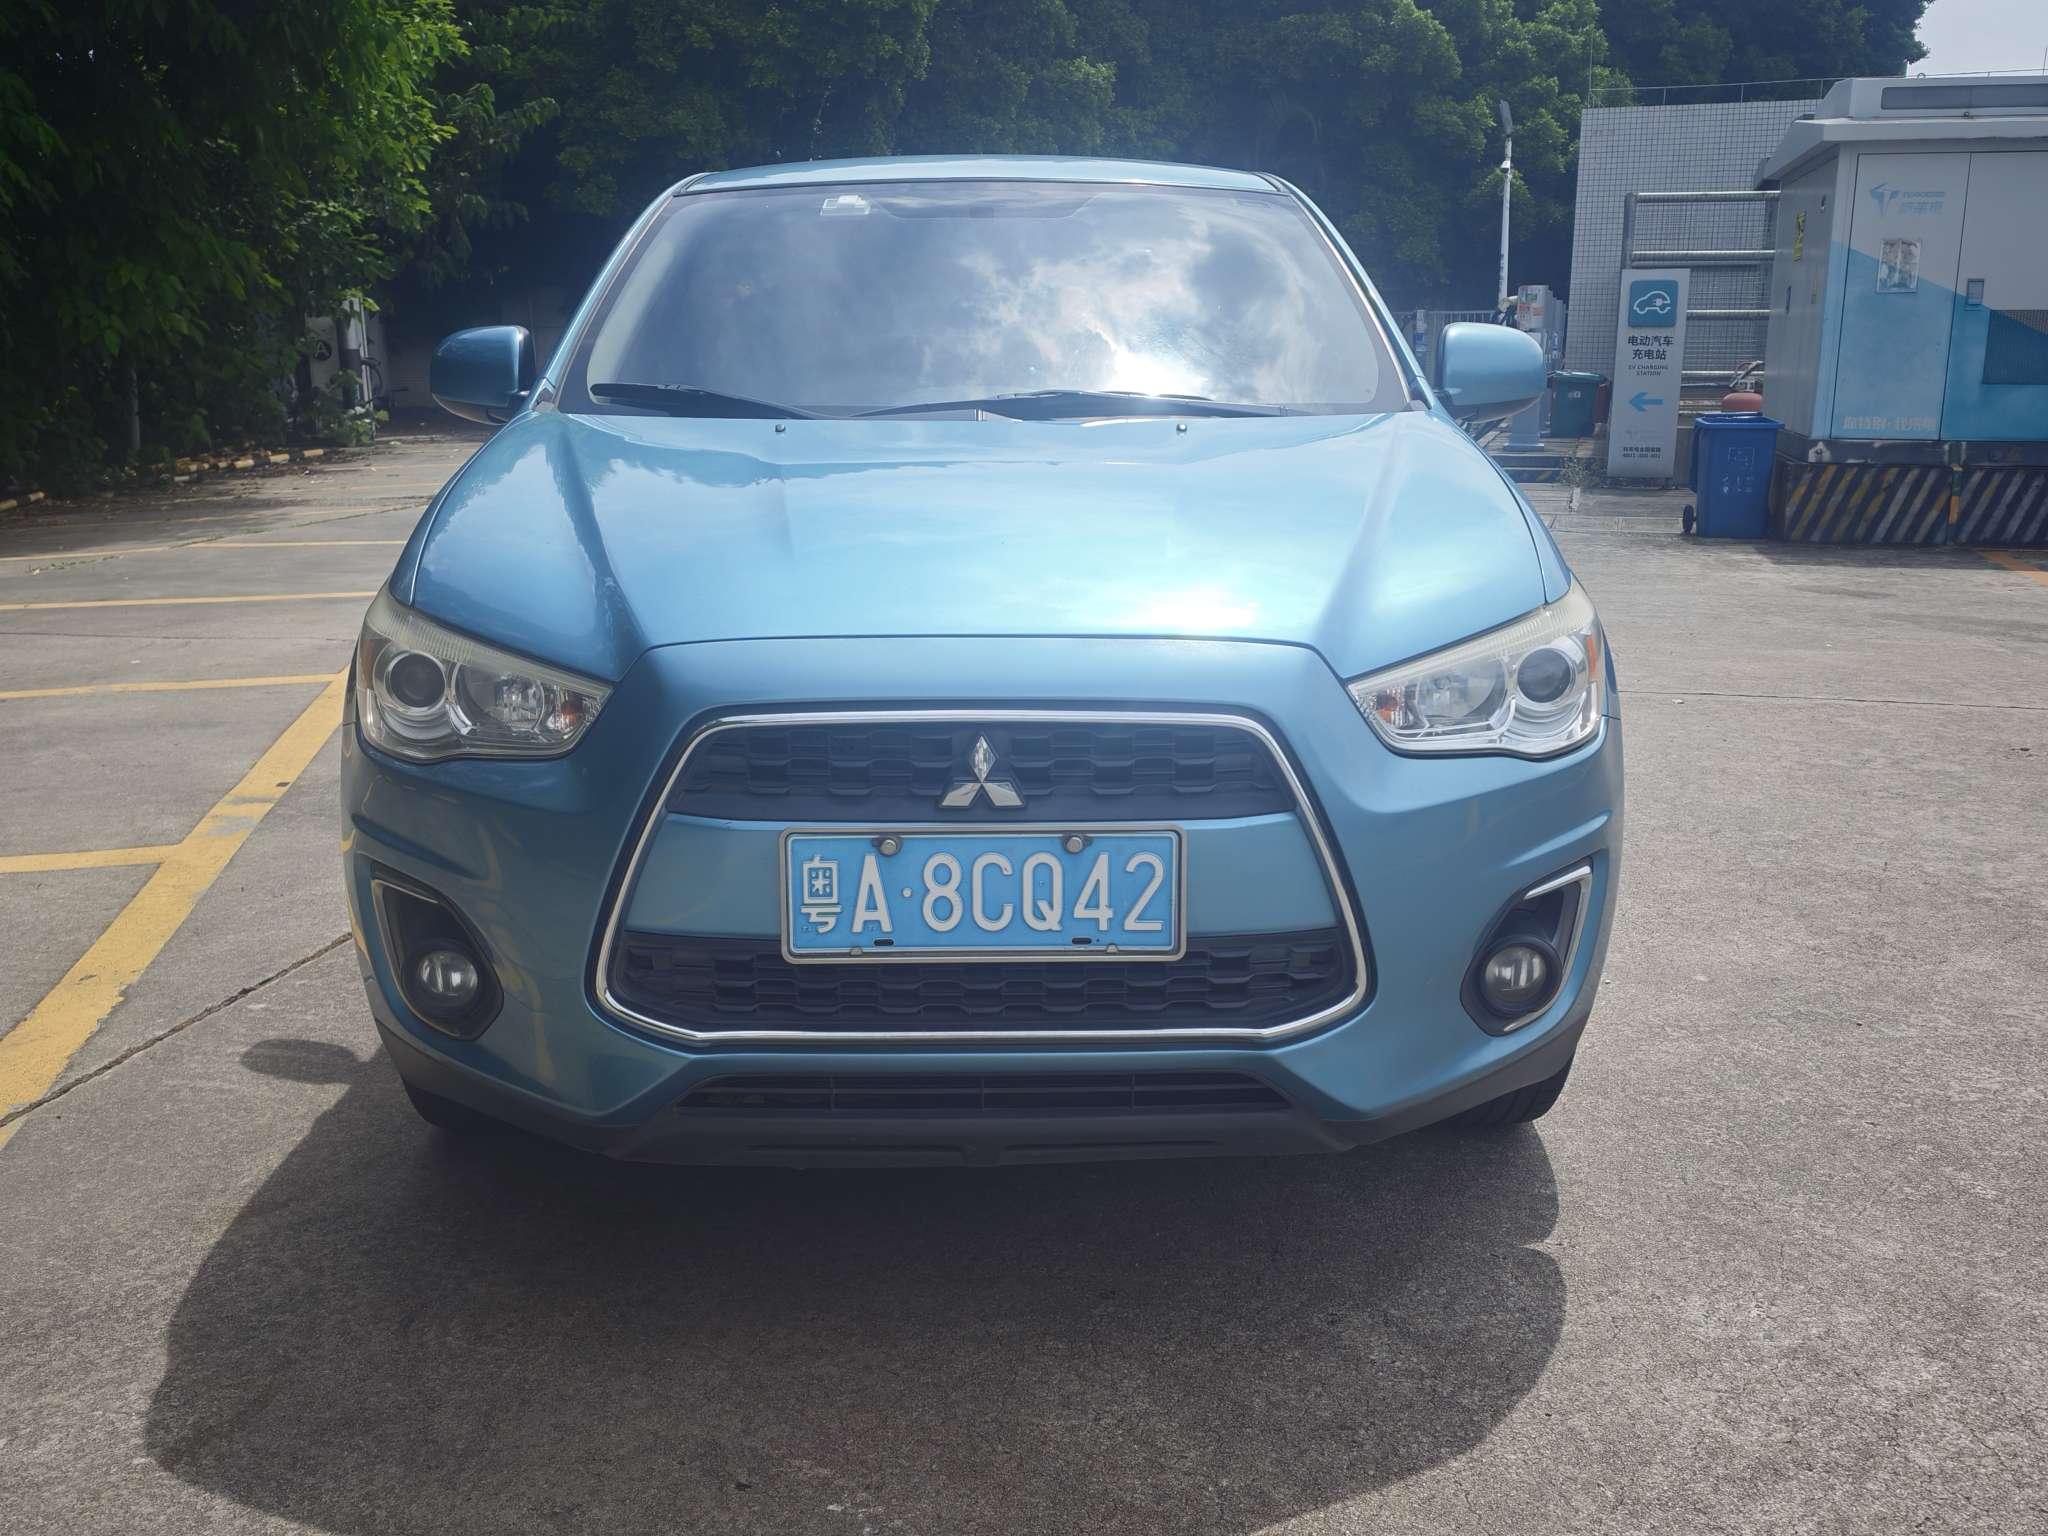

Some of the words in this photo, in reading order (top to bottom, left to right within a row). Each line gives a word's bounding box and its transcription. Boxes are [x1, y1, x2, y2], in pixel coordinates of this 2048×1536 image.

[1628, 335, 1675, 347] 电动汽车
[1632, 349, 1667, 361] 充电站
